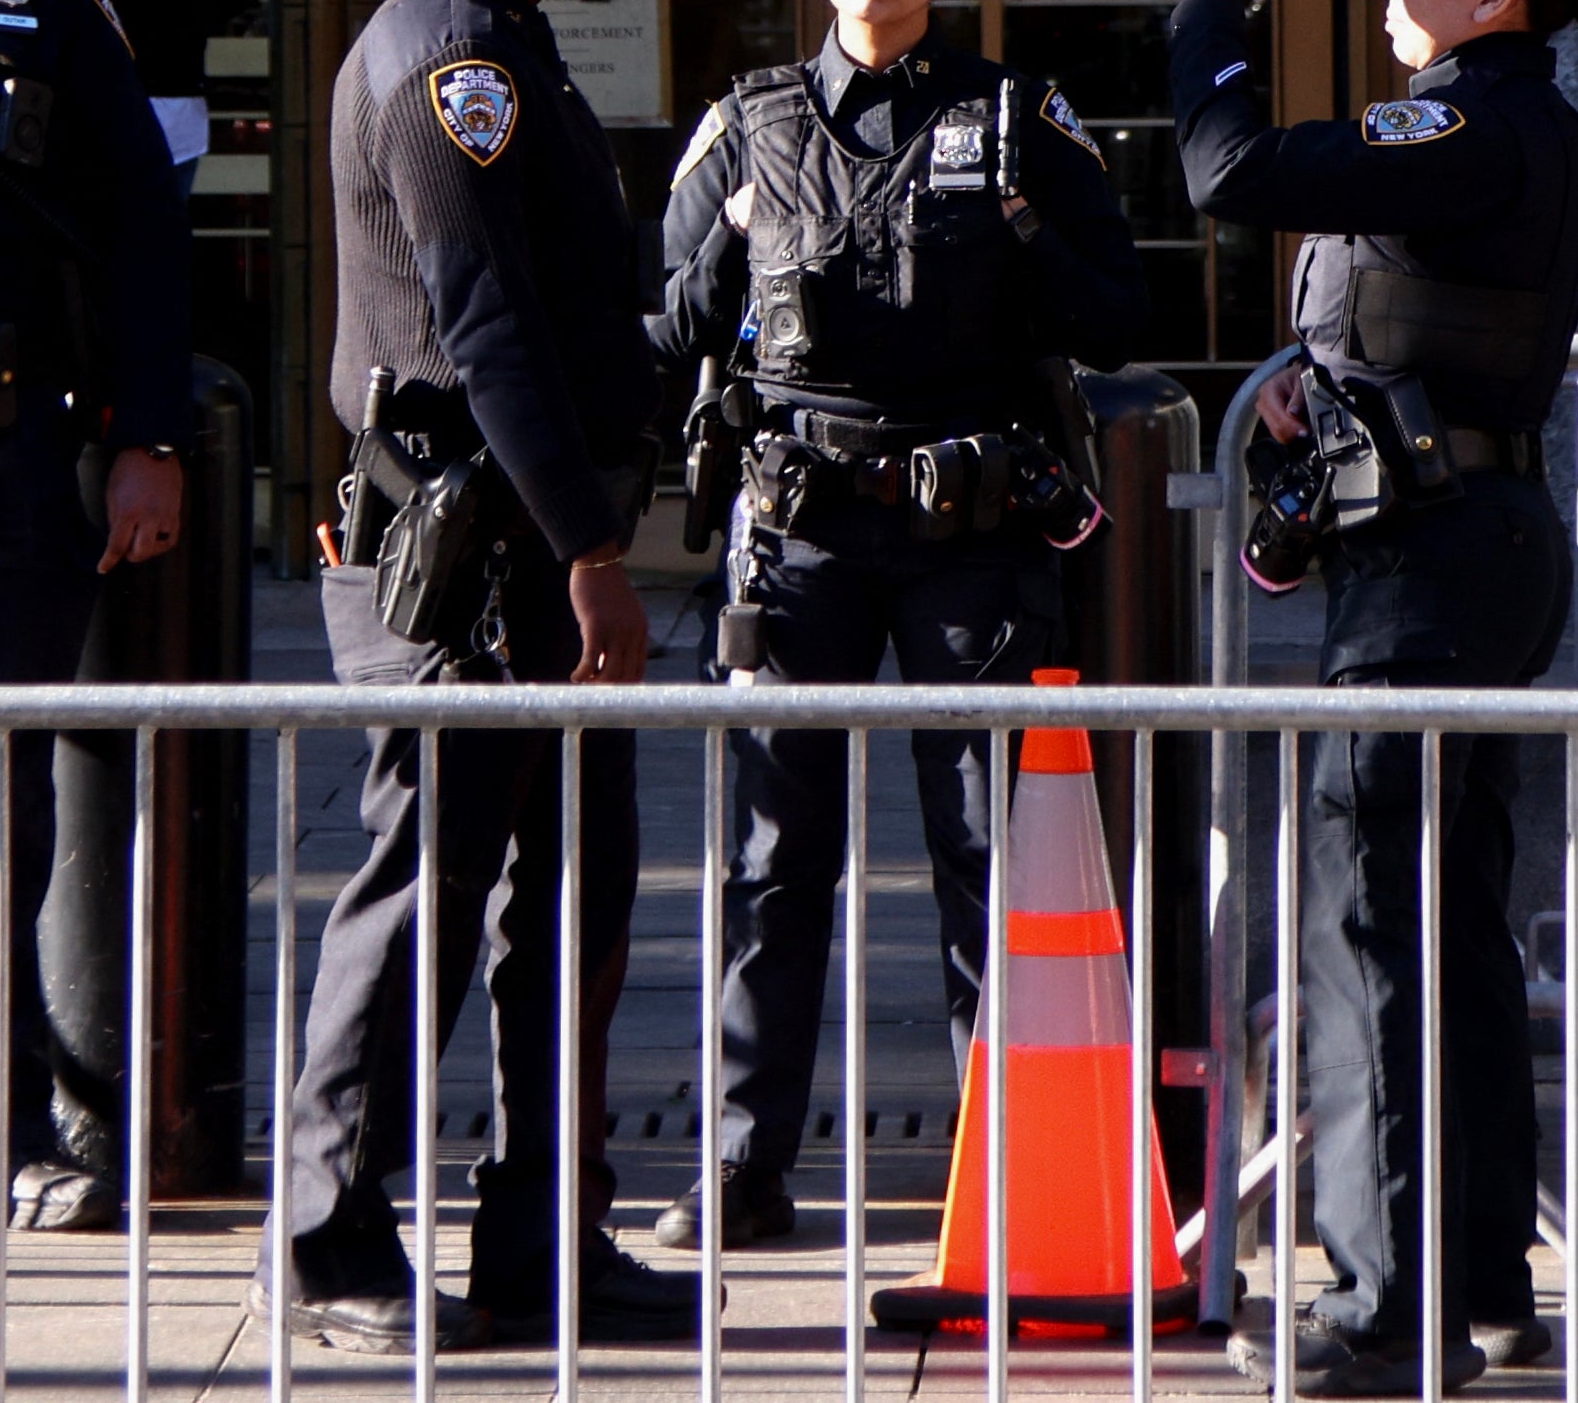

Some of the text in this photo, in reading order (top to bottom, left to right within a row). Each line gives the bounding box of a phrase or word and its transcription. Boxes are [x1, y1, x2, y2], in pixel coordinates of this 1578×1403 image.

[553, 27, 643, 40] FORCEMENT
[453, 68, 496, 82] POLICE
[440, 79, 509, 98] DEPARTMENT
[443, 108, 475, 147] CITY OF
[487, 102, 514, 153] NEW YORK
[1380, 127, 1439, 141] NEW YORK
